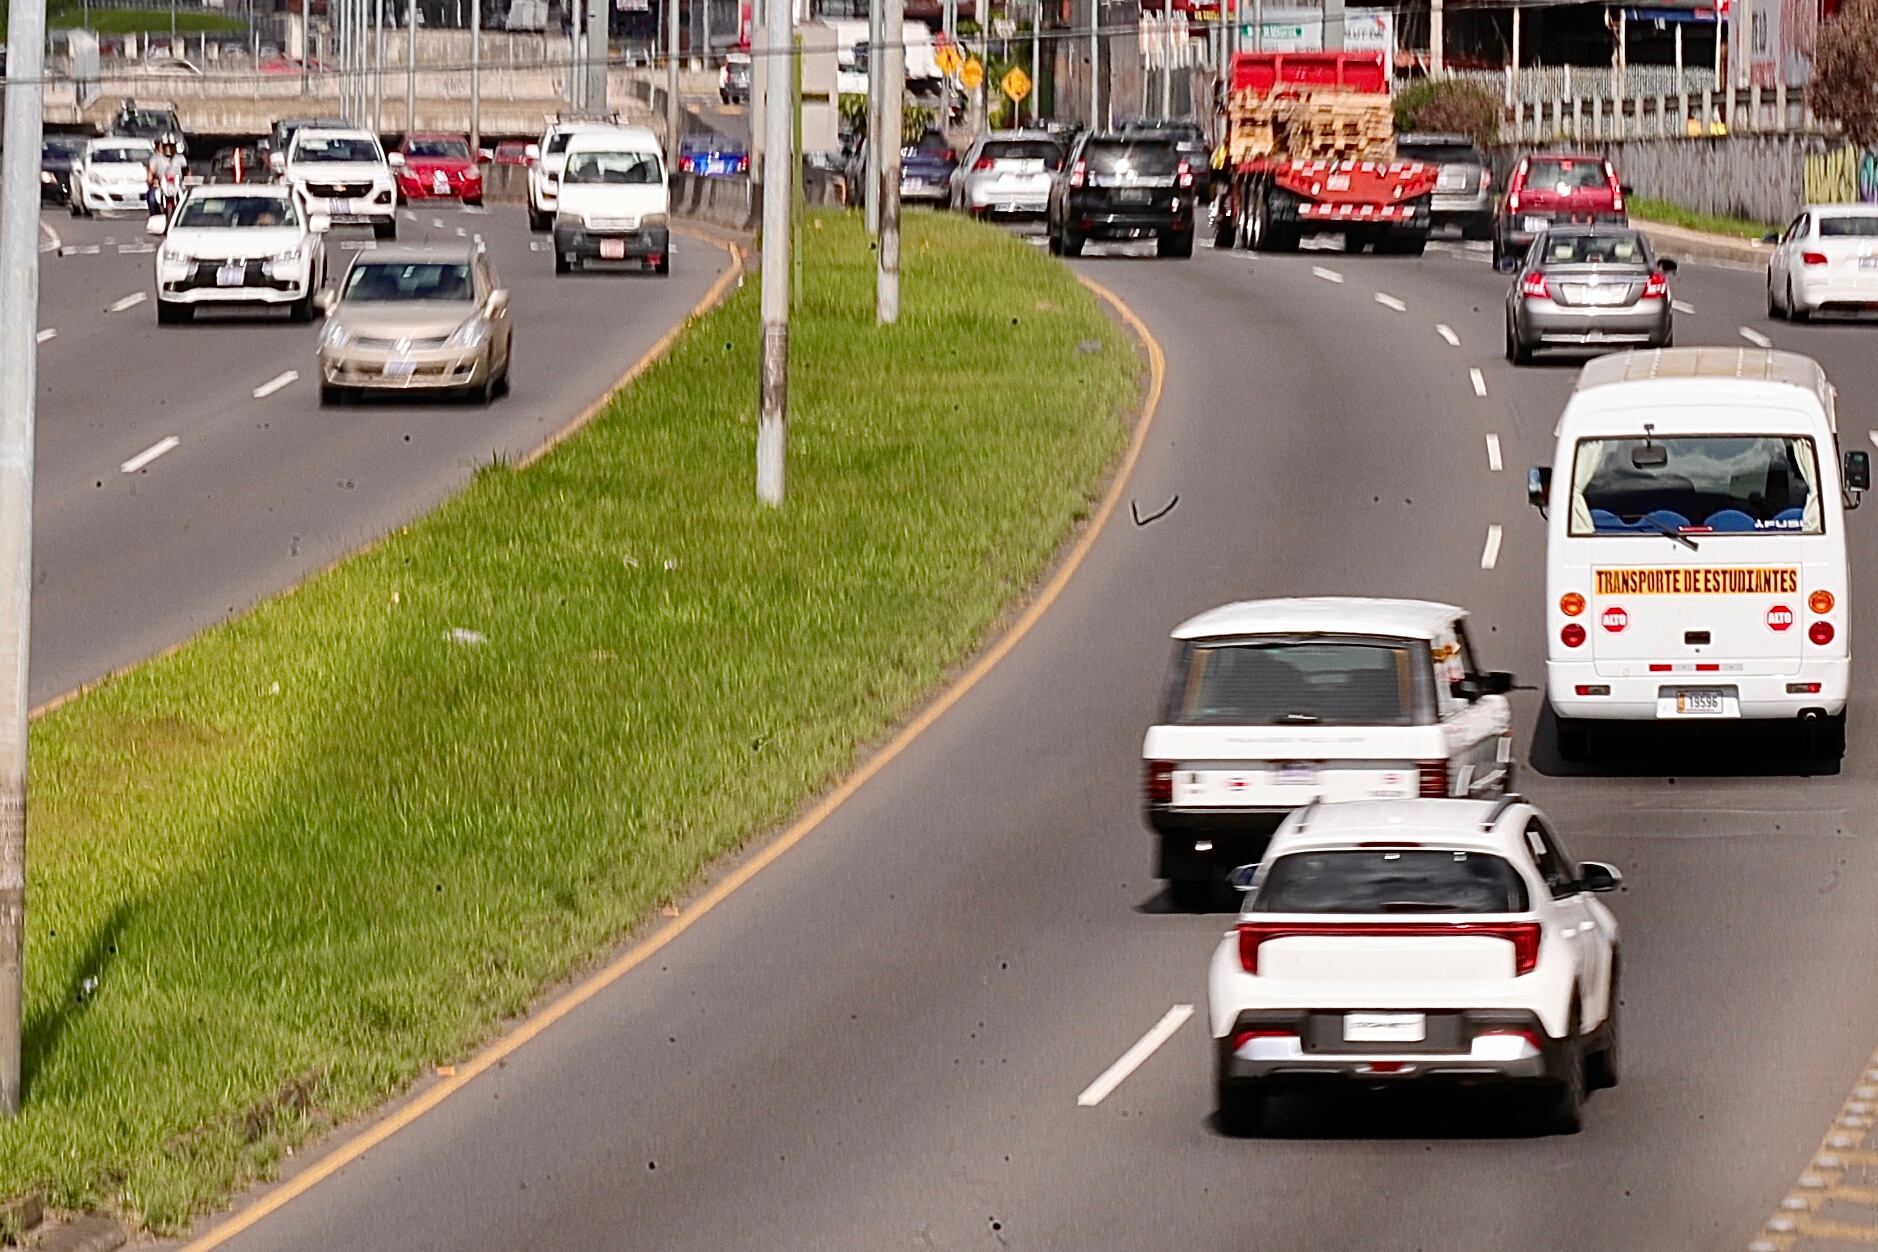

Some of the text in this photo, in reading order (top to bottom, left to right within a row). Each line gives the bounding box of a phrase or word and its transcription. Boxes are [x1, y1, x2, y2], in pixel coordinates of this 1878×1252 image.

[1596, 569, 1796, 593] TRANSPORTE DE ESTUDIANTES
[1603, 613, 1627, 626] ALTO
[1768, 611, 1792, 624] ALTO
